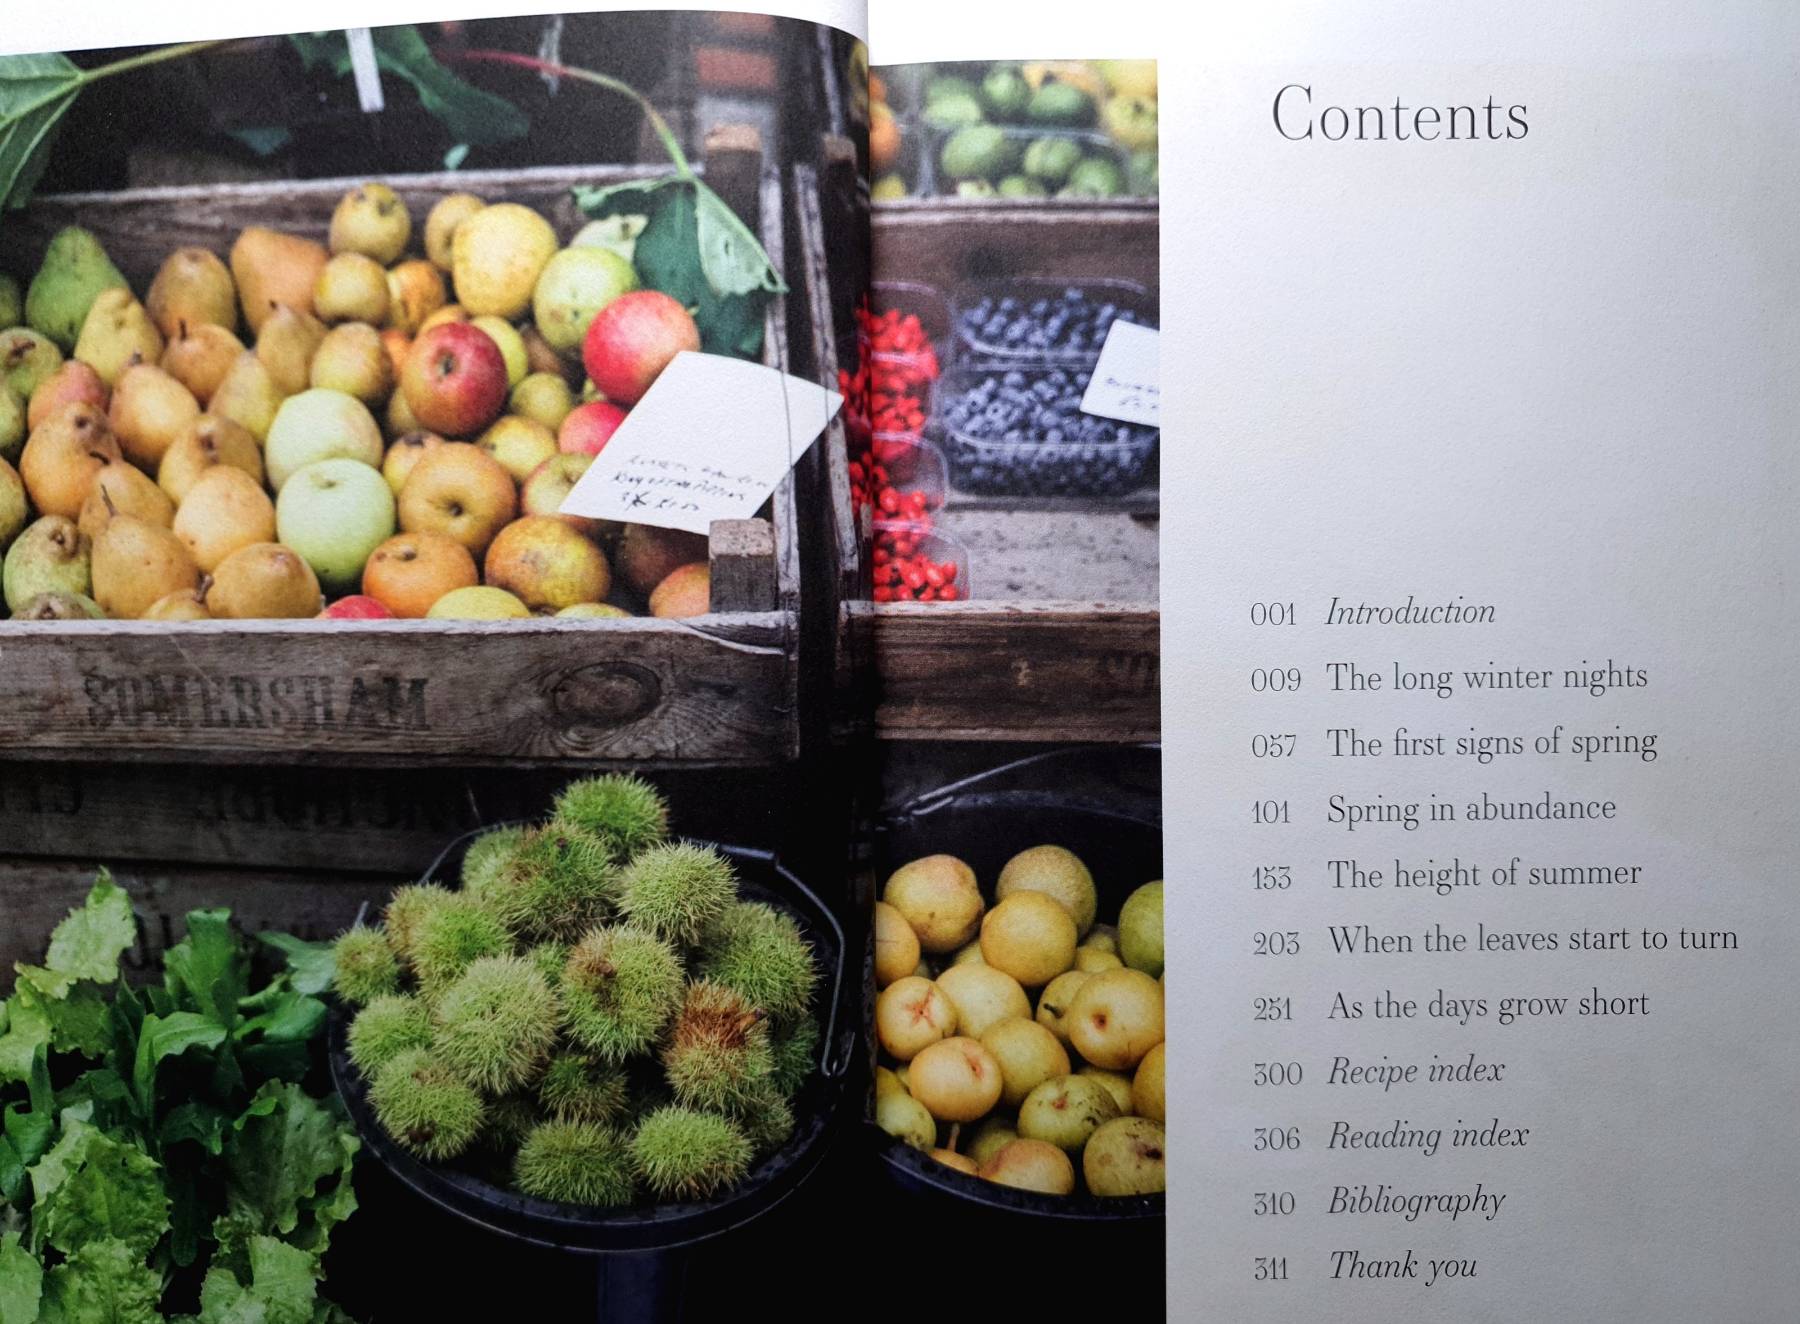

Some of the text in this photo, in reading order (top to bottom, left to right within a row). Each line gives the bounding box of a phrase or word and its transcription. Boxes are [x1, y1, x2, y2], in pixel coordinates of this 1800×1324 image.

[1273, 84, 1528, 141] Contents
[1251, 596, 1495, 626] 001 Introduction
[1251, 659, 1647, 699] 009 The long winter nights
[1252, 725, 1658, 764] 057 The first signs of spring
[1252, 791, 1616, 831] 101 Spring in abundance
[1252, 857, 1642, 896] 153 The height of summer
[1253, 923, 1738, 955] 203 When the leaves start to turn
[1254, 987, 1650, 1025] 251 As the days grow short
[1254, 1053, 1506, 1092] 300 Recipe index
[1254, 1118, 1530, 1156] 306 Reading index
[1254, 1184, 1506, 1222] 310 Bibliography
[1255, 1250, 1477, 1287] 311 Thank you
